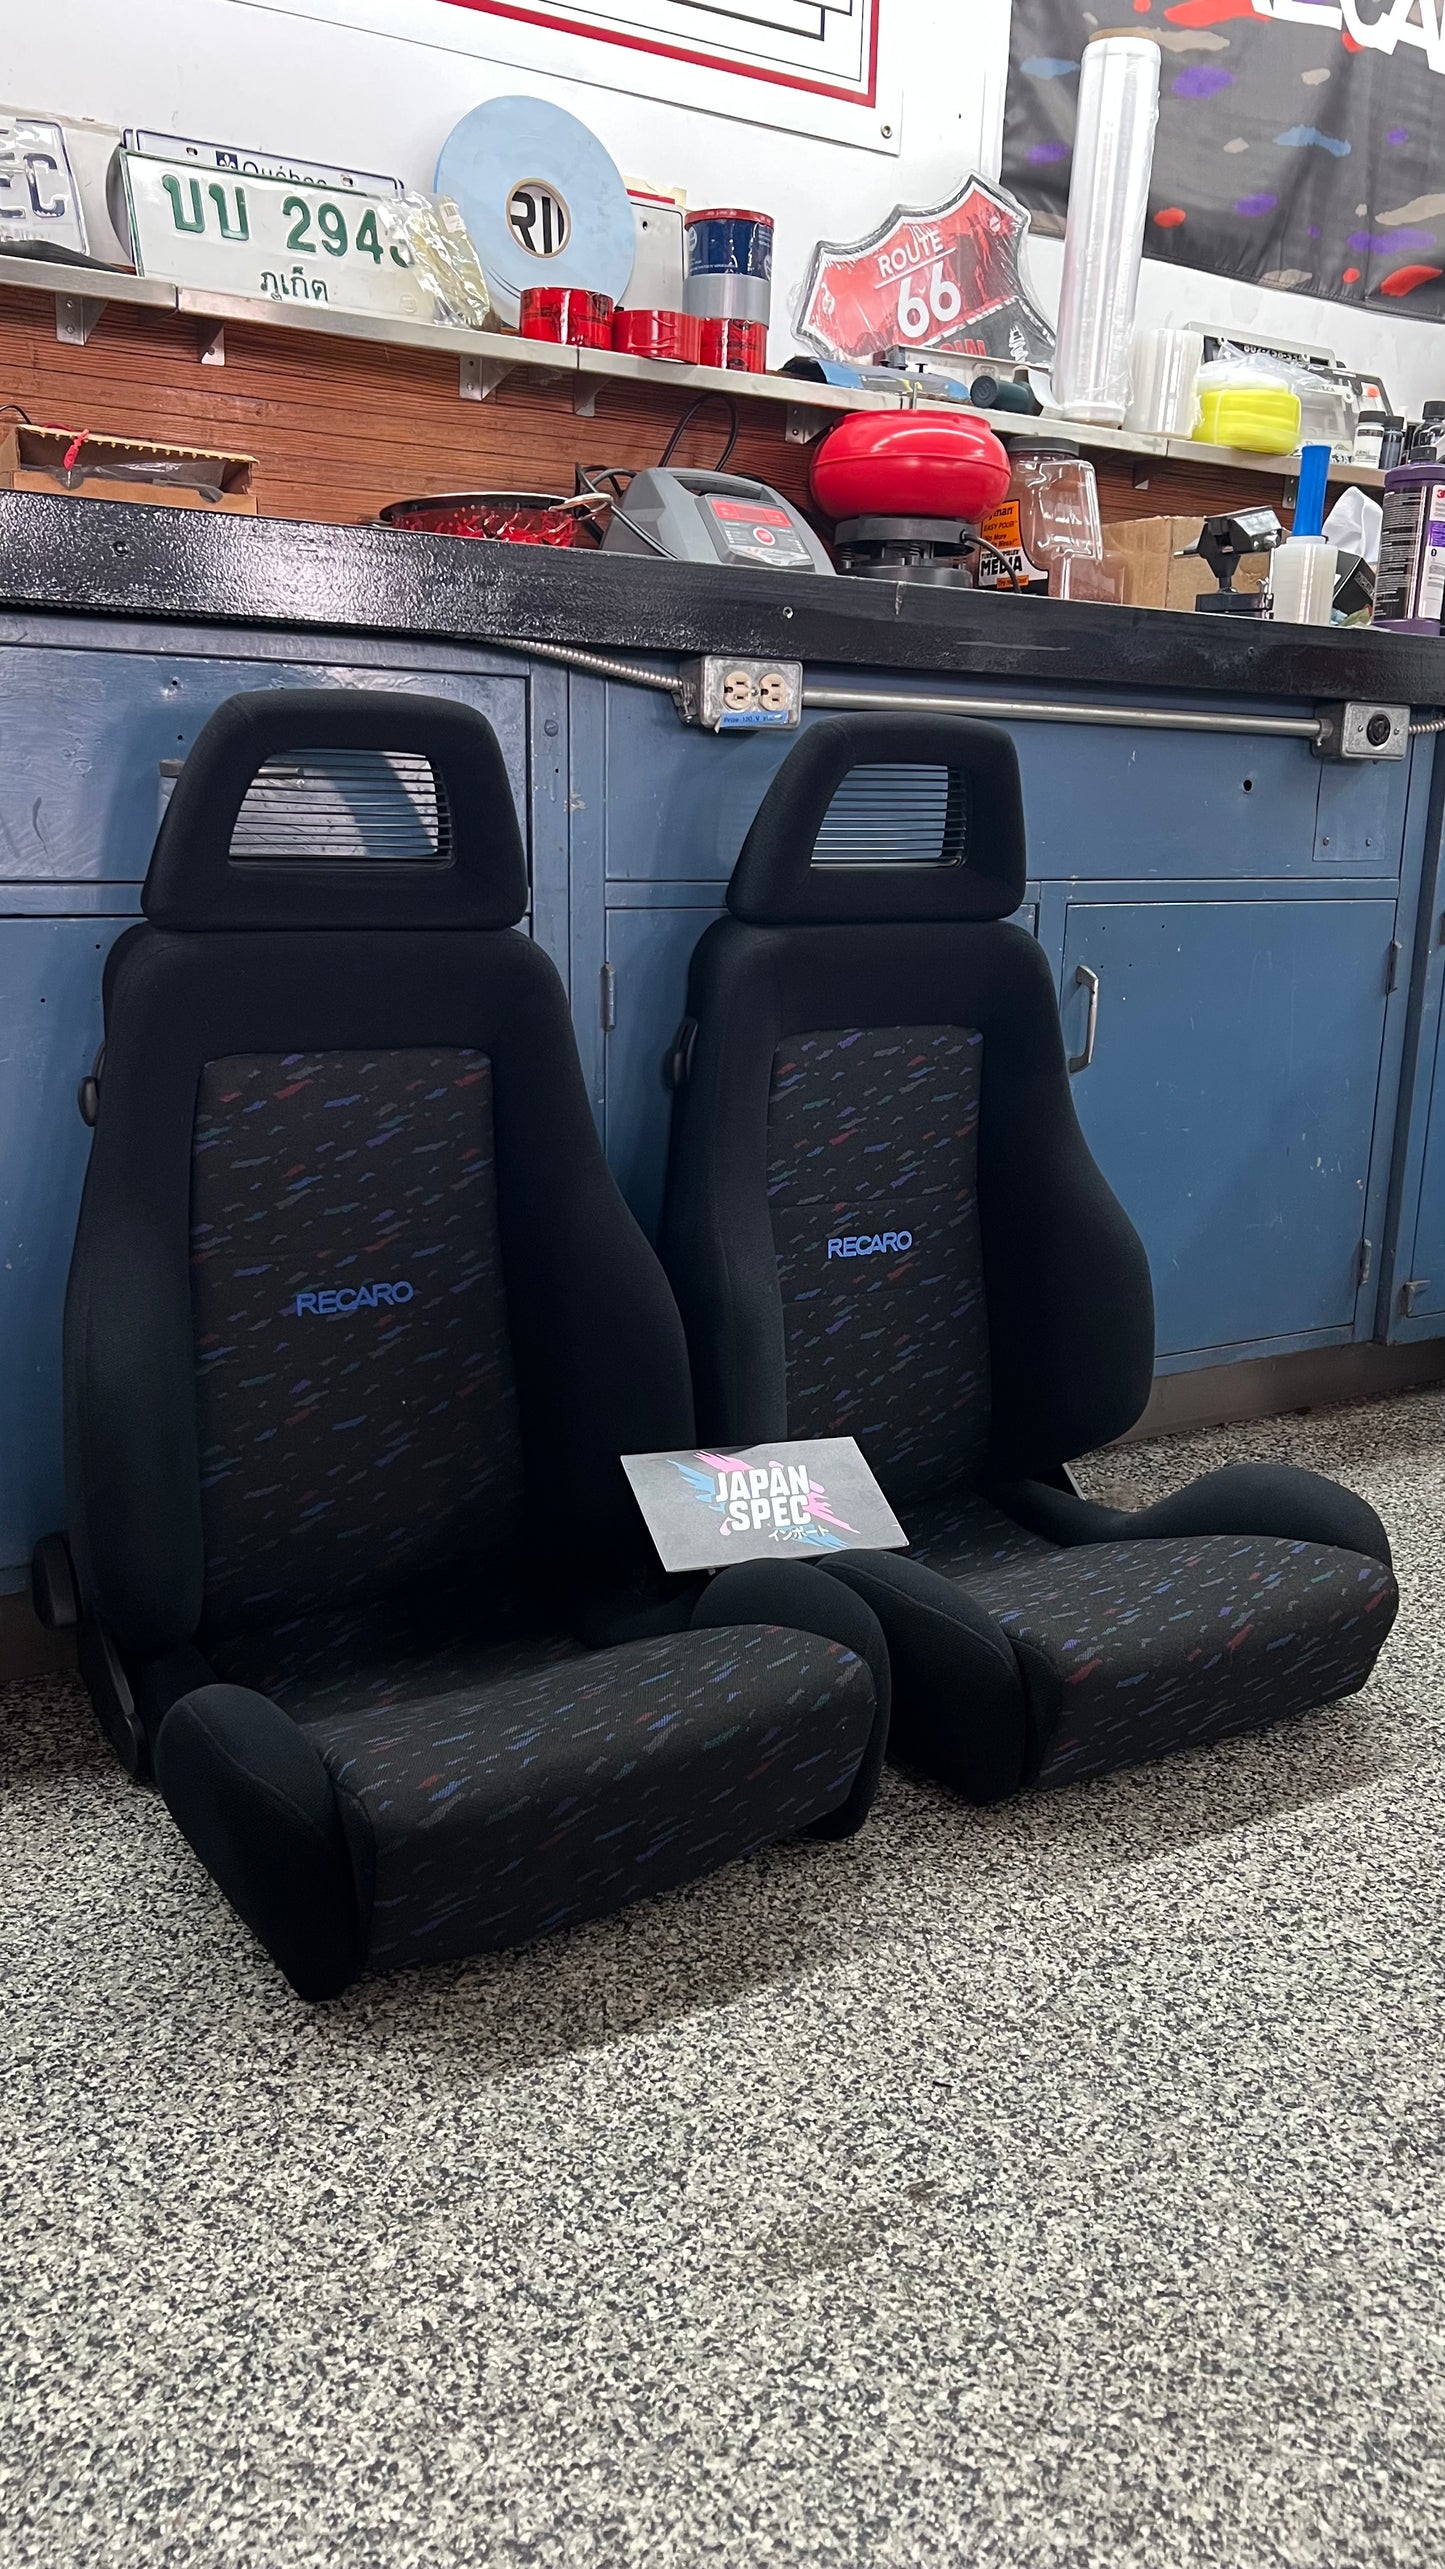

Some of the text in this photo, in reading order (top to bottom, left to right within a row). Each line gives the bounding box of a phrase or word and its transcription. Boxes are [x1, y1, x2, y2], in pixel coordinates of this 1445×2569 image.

[161, 174, 249, 241] บบ
[510, 191, 565, 254] RI
[876, 229, 944, 278] ROUTE
[897, 260, 962, 338] 66
[827, 1230, 913, 1259] RECARO
[296, 1280, 414, 1317] RECARO
[716, 1464, 811, 1503] JAPAN
[728, 1493, 811, 1532] SPEC
[768, 1525, 829, 1542] インポート
